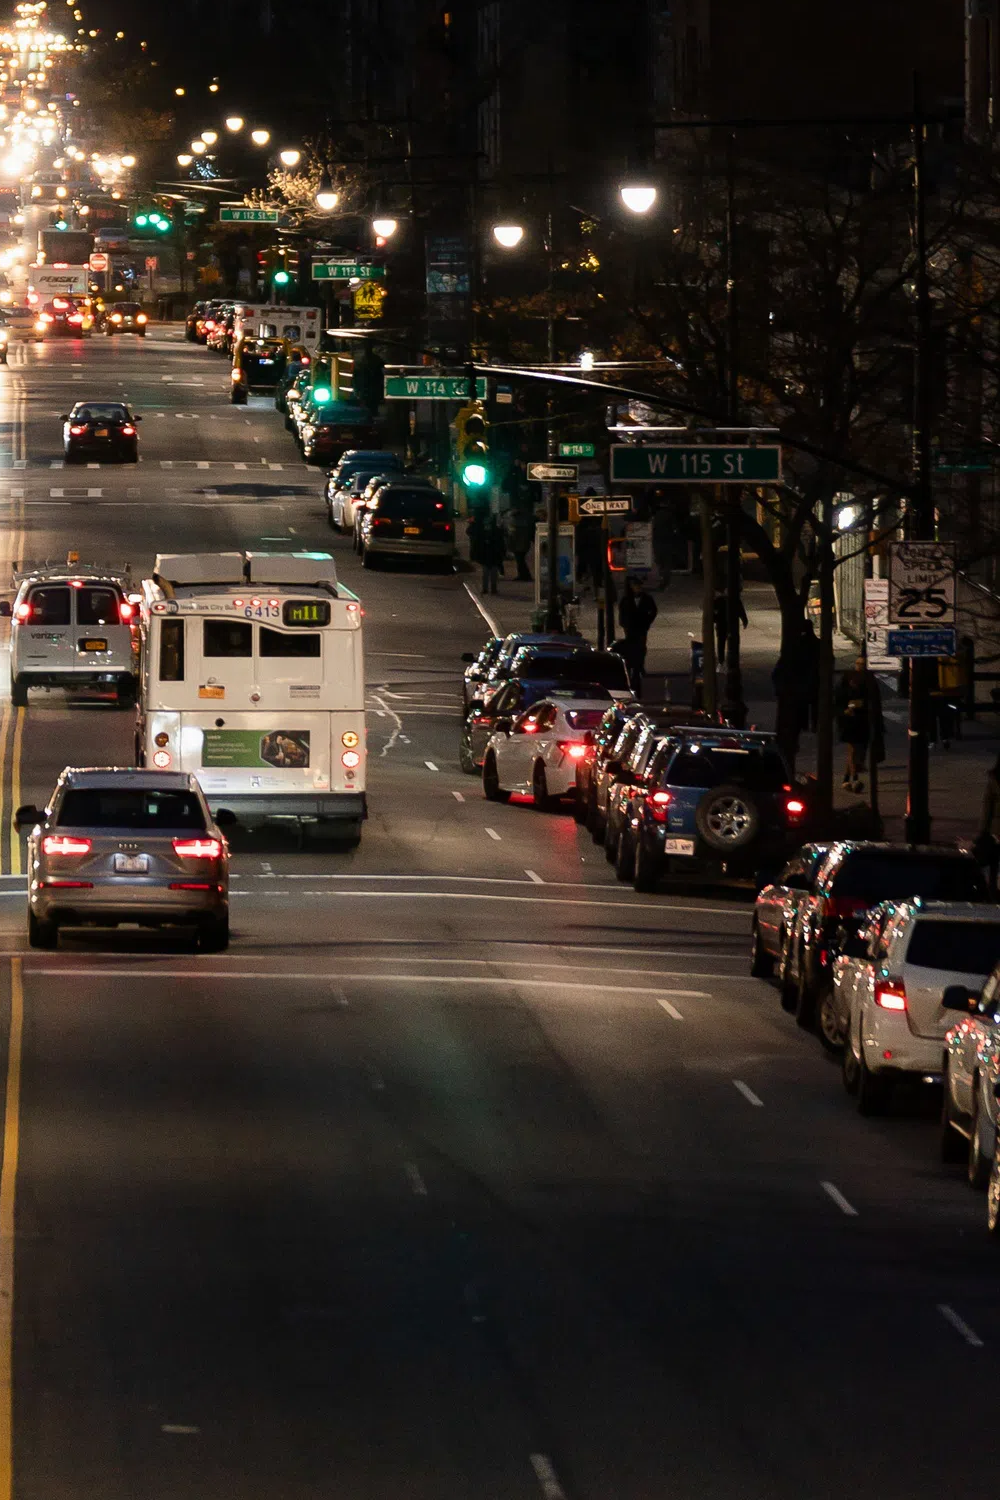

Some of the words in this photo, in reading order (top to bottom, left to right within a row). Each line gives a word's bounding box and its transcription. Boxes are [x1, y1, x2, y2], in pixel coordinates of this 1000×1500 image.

[232, 212, 241, 220] W
[327, 266, 338, 277] W
[341, 266, 357, 277] 113
[360, 266, 371, 277] St
[39, 275, 80, 283] PENSKE
[405, 381, 419, 394] W
[425, 381, 447, 395] 114
[647, 454, 668, 474] W
[680, 454, 712, 475] 115
[723, 453, 745, 475] St
[556, 469, 575, 477] WAY
[585, 502, 602, 510] ONE
[907, 574, 940, 584] LIMIT
[210, 603, 224, 611] City
[898, 587, 948, 618] 25
[244, 605, 280, 618] 6413
[293, 605, 319, 620] M11
[31, 631, 63, 640] verizon
